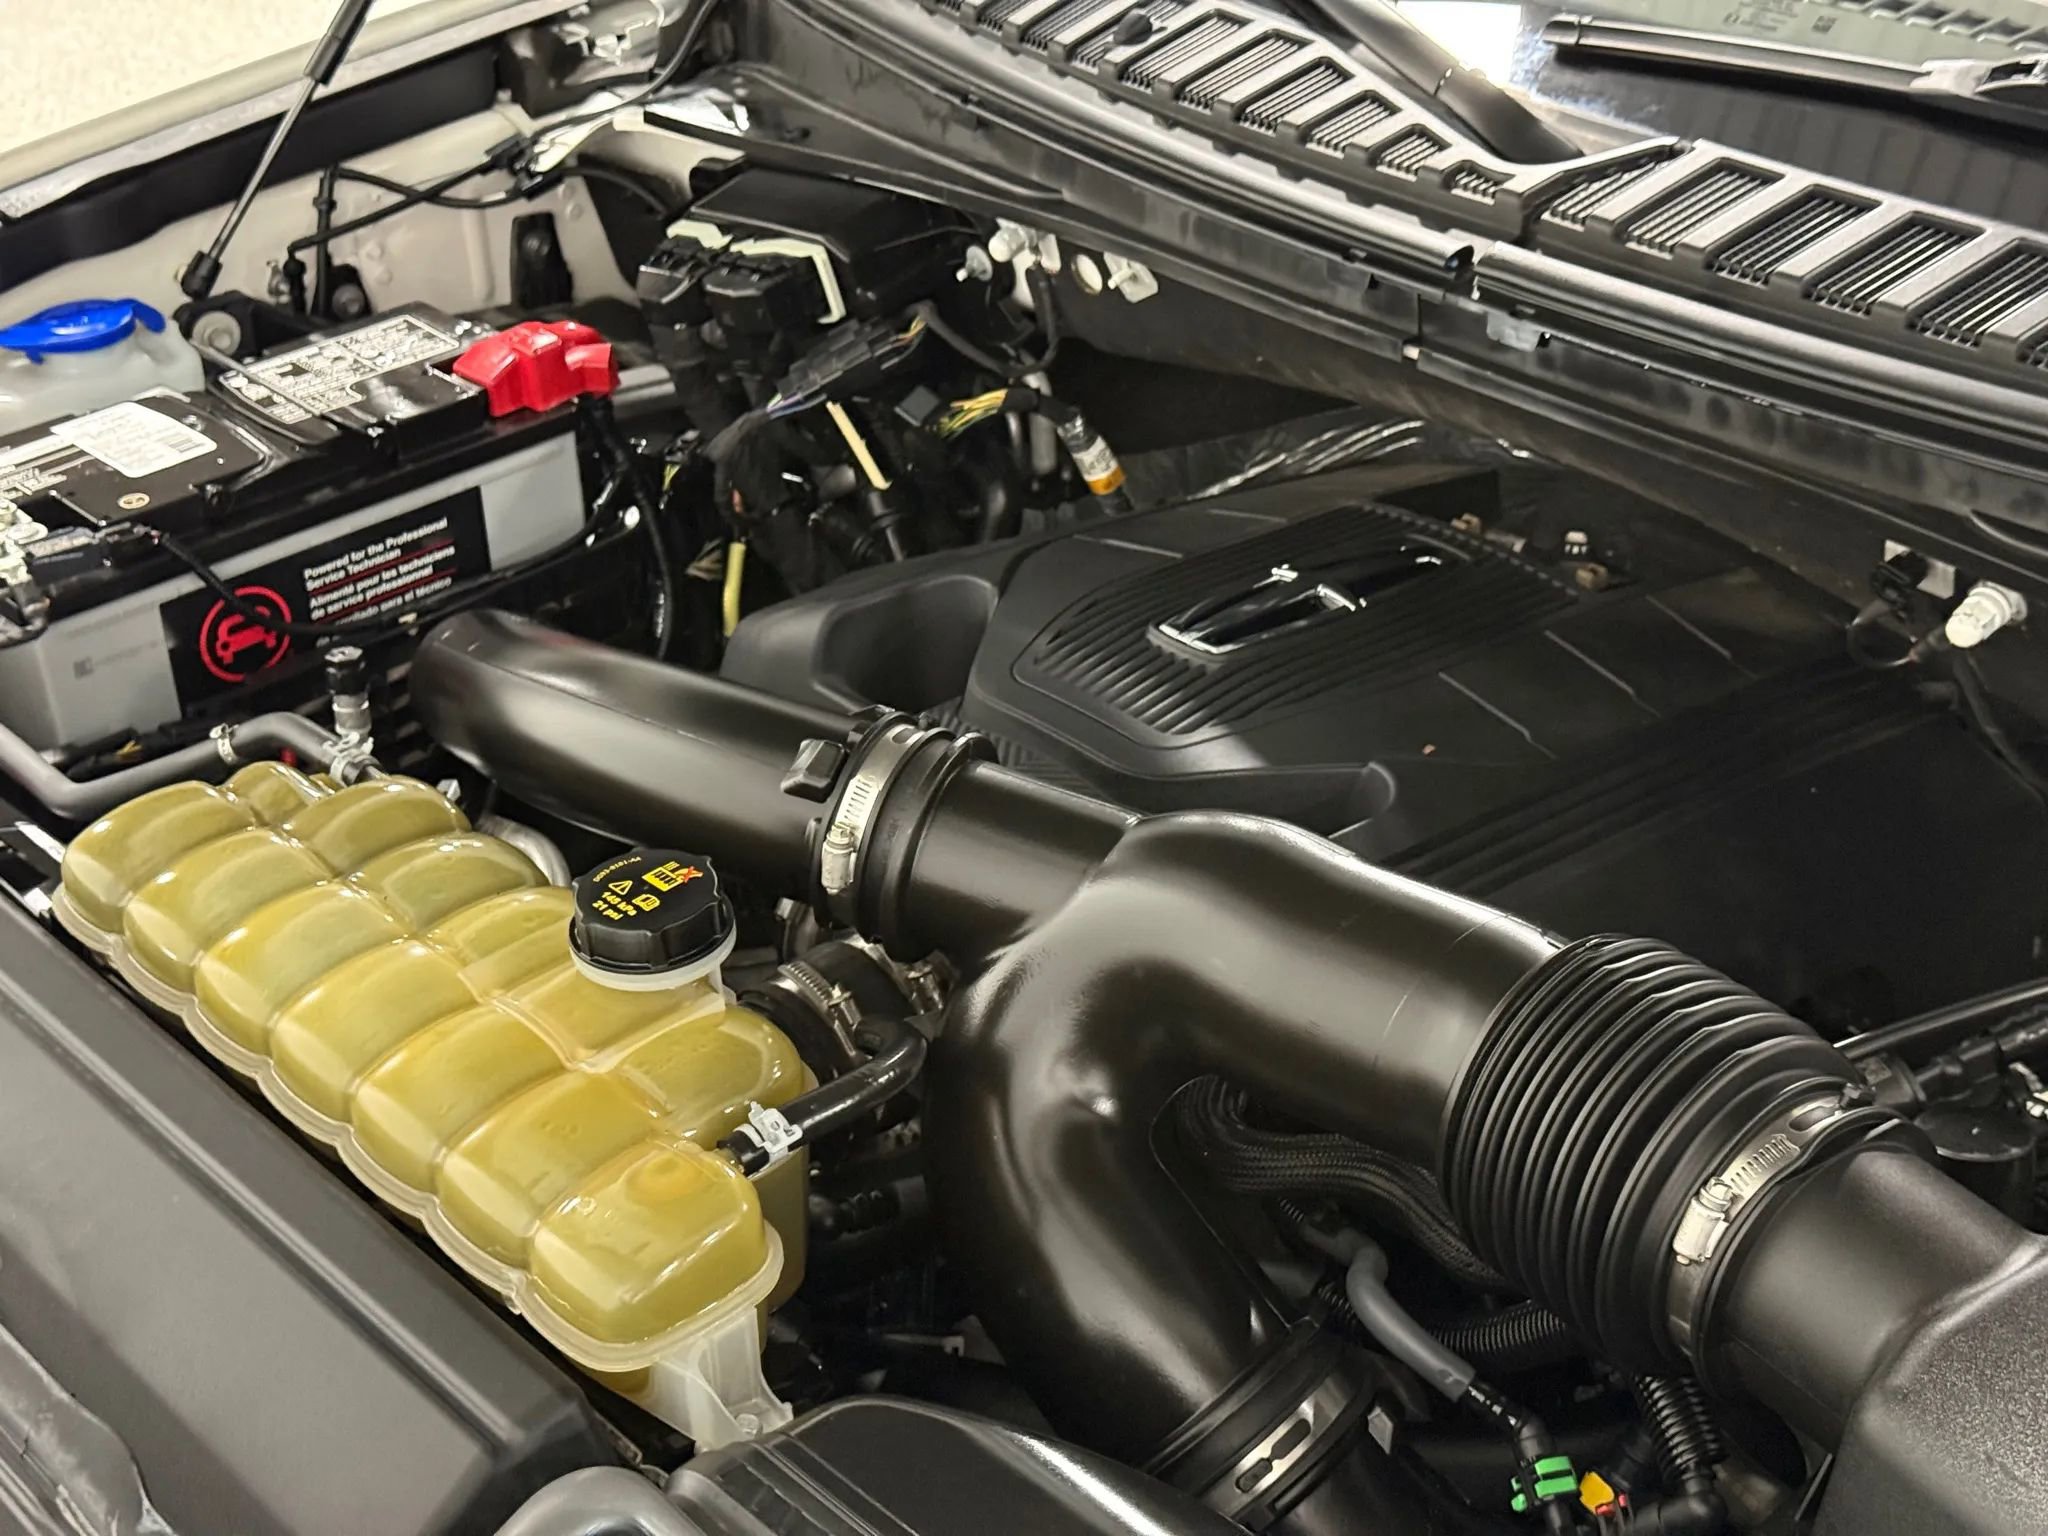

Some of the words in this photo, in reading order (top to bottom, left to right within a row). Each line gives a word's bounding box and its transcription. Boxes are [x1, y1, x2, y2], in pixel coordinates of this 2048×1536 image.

[304, 554, 350, 580] Powered
[351, 549, 366, 562] for
[367, 542, 384, 556] the
[386, 517, 448, 548] Professional
[306, 570, 346, 592] Service
[347, 548, 402, 576] Technician
[356, 574, 380, 593] pour
[382, 568, 398, 581] les
[398, 545, 455, 572] techniciens
[311, 607, 326, 621] de
[327, 593, 365, 615] service
[592, 900, 608, 911] 21
[603, 909, 623, 920] psi
[602, 892, 621, 904] 145
[617, 902, 637, 916] kPa
